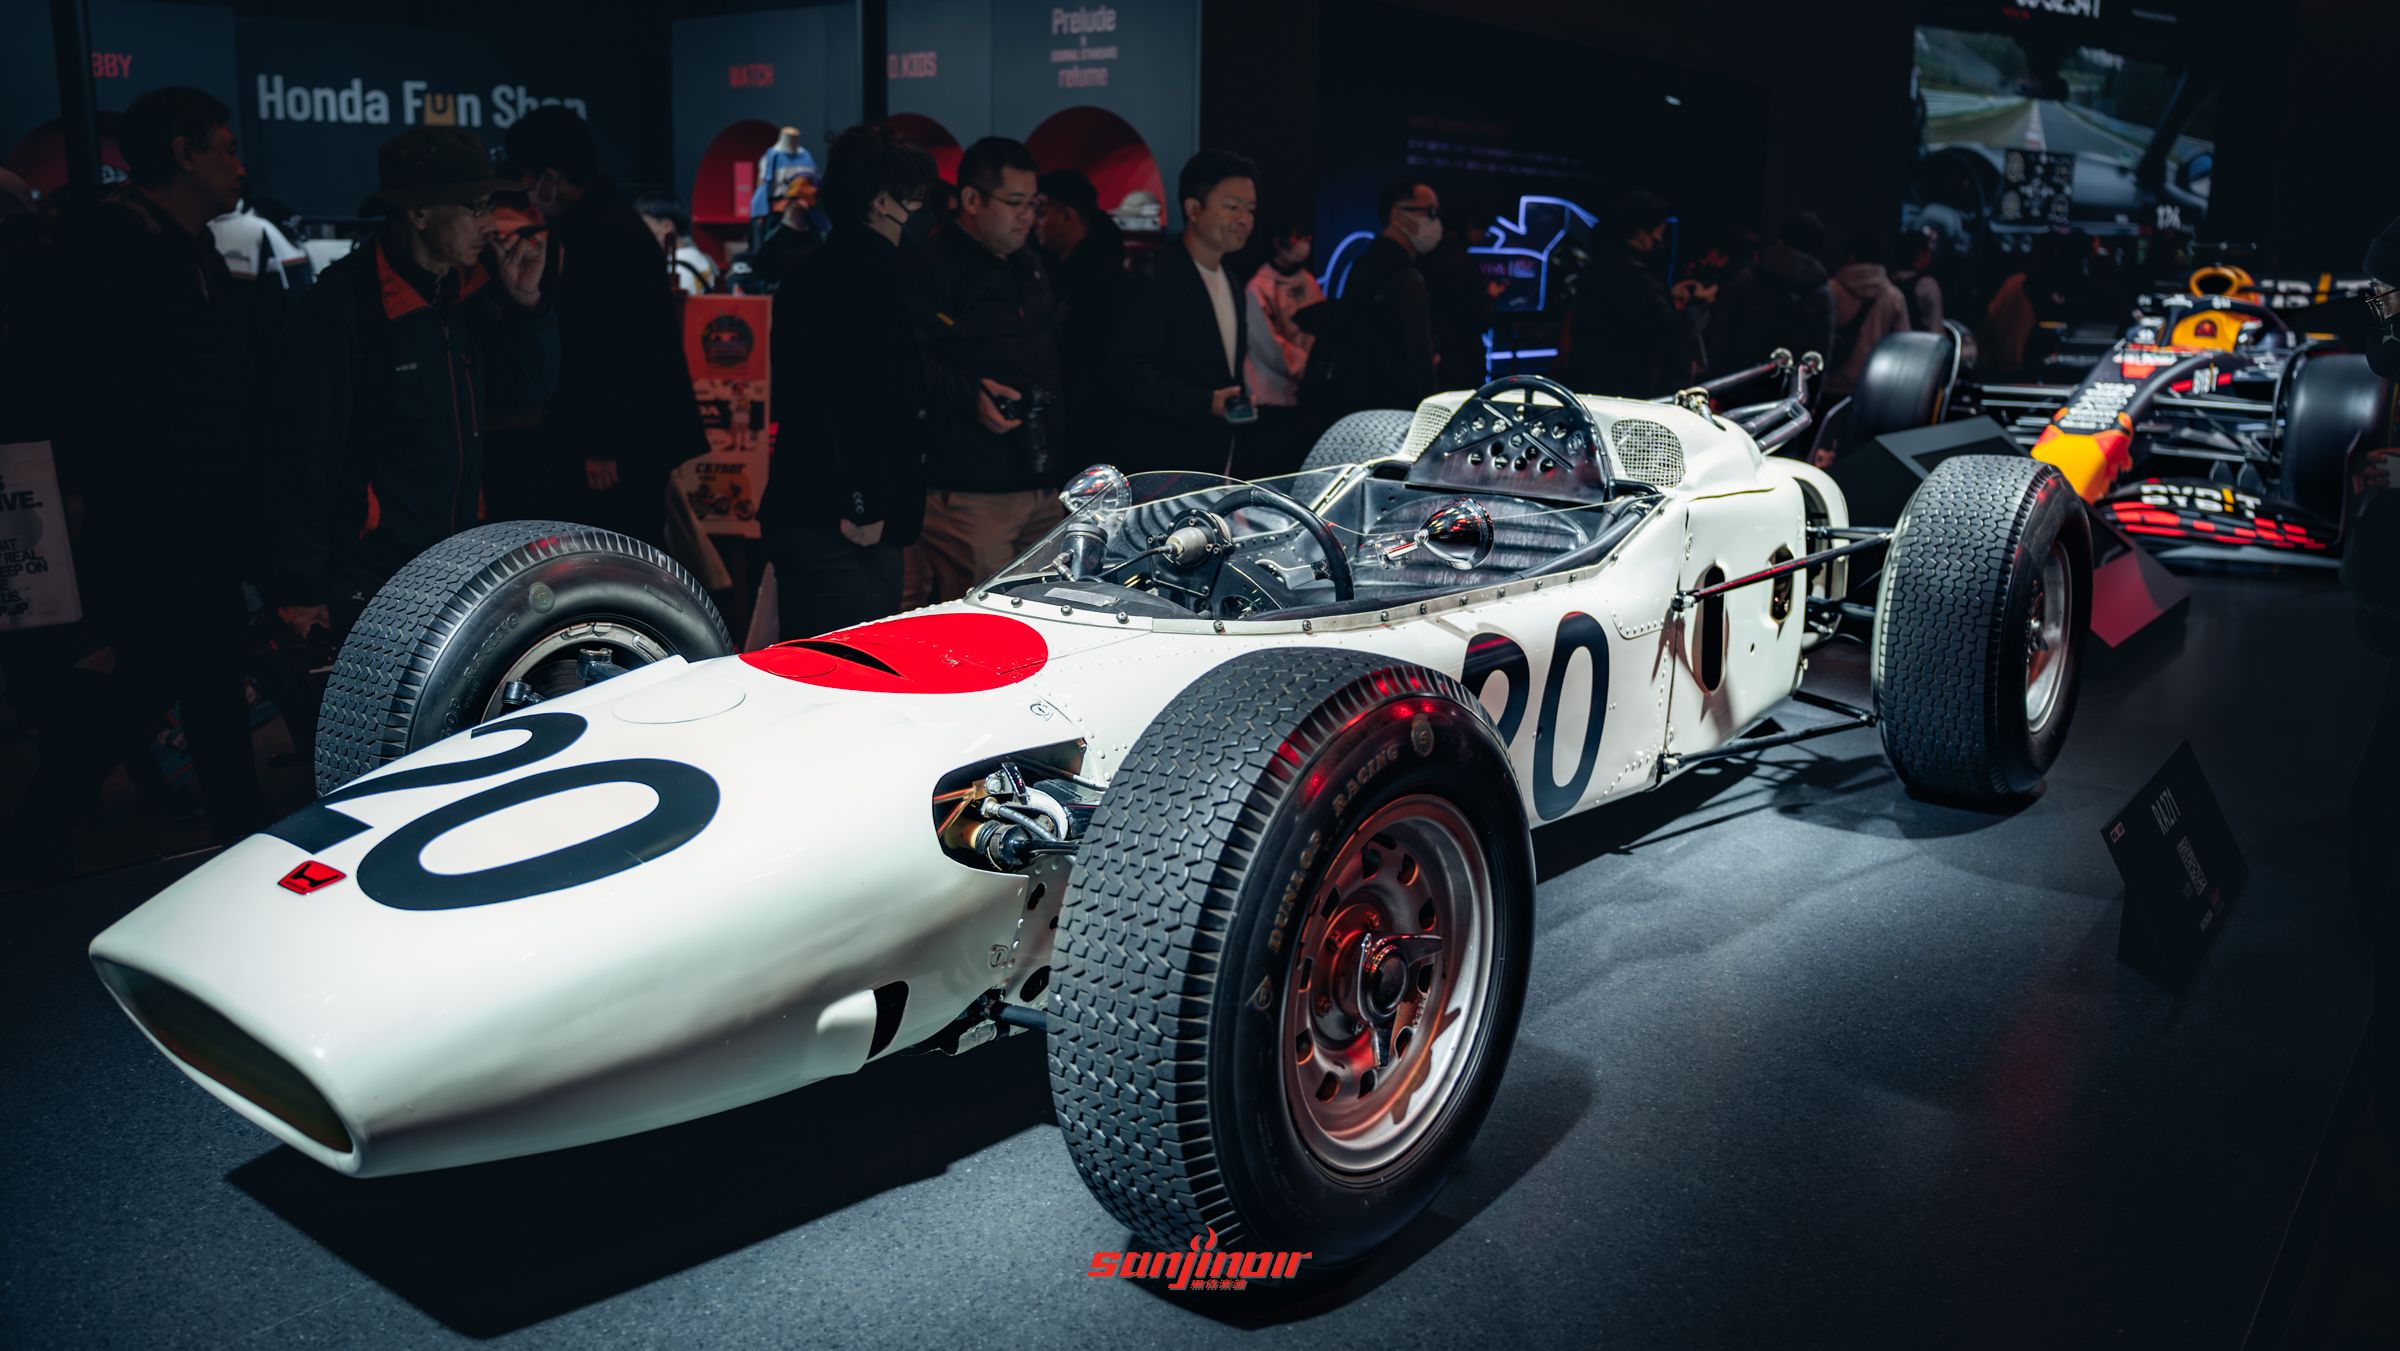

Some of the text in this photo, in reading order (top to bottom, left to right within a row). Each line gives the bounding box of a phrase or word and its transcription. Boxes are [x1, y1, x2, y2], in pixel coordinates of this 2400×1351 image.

[1051, 5, 1117, 34] Prelude
[91, 53, 132, 79] BBY
[256, 74, 391, 125] Honda
[402, 79, 483, 128] Fun
[0, 561, 48, 577] EEP ON
[1333, 743, 1400, 818] RACING
[257, 711, 721, 912] 20
[1267, 829, 1322, 952] DUNLOP
